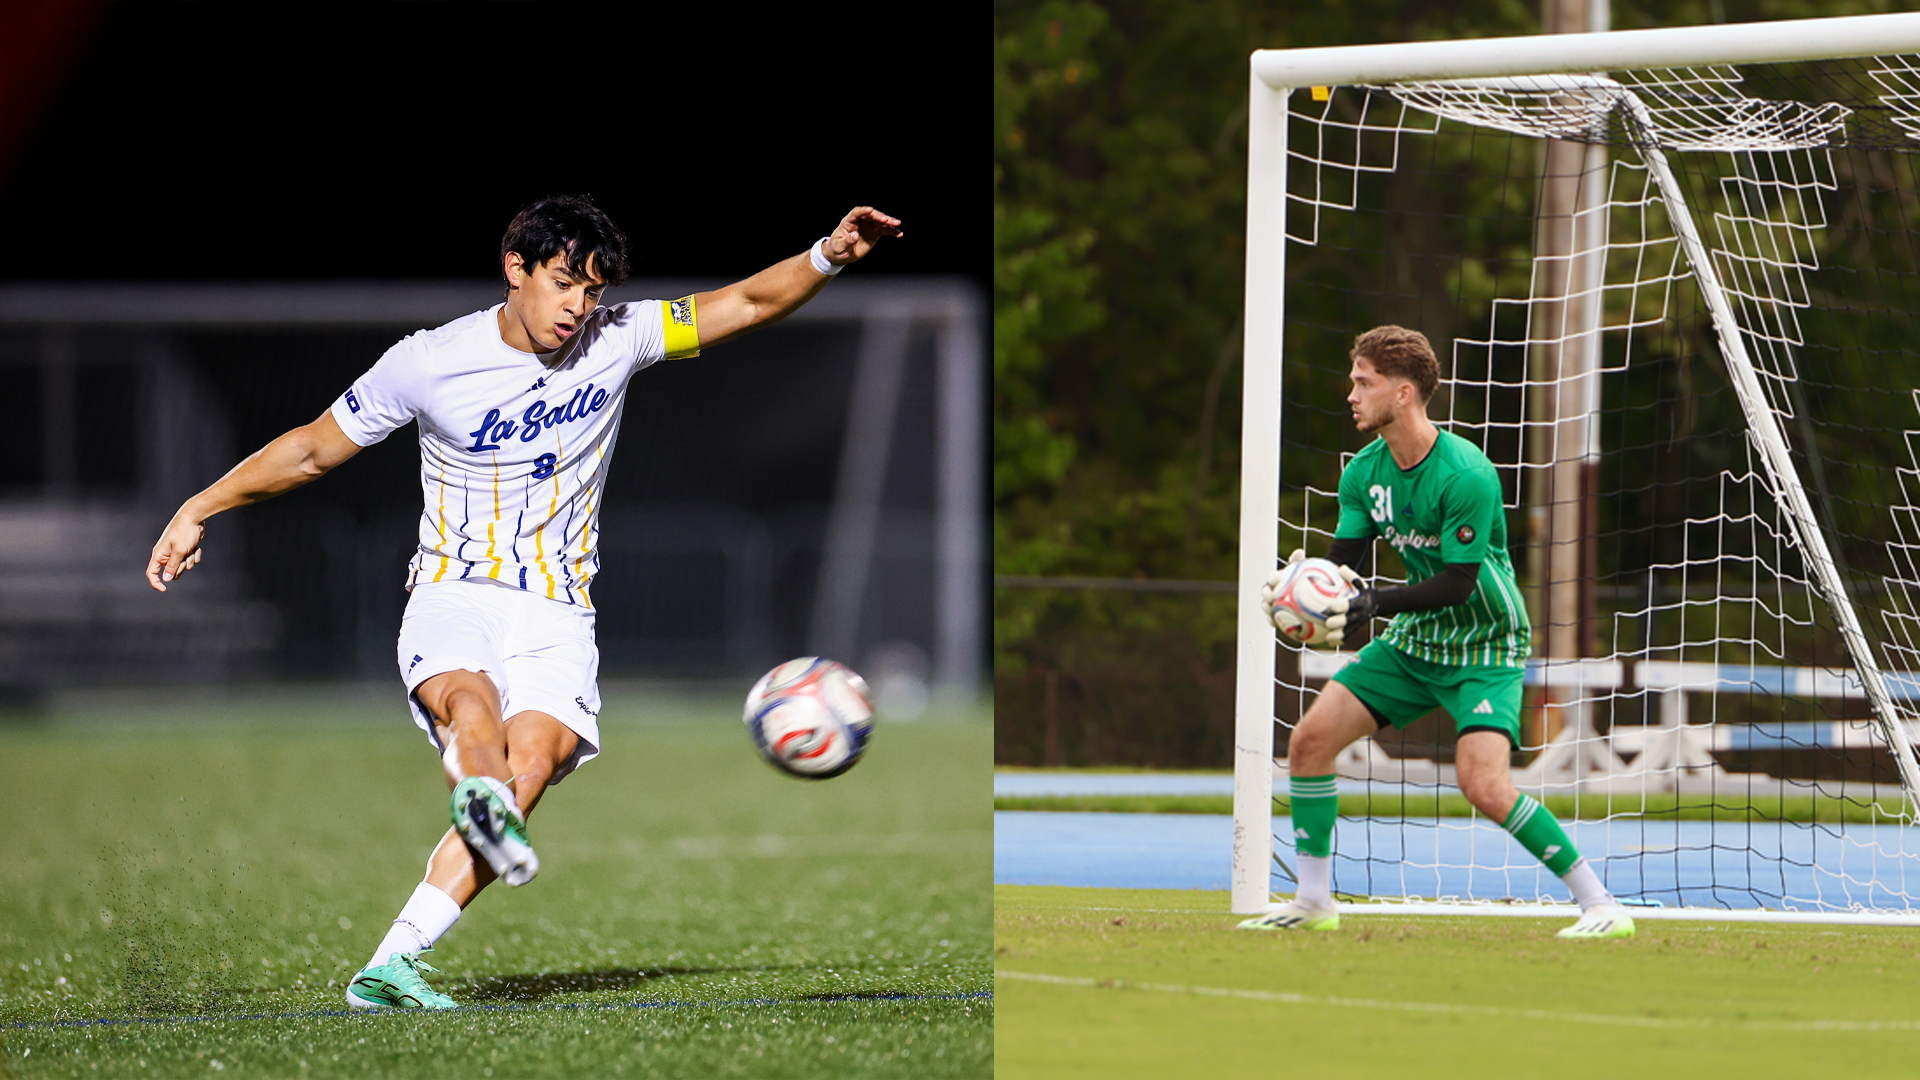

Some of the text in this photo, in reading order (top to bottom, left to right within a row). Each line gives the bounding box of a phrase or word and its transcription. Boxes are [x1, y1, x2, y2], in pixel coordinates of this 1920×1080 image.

[344, 383, 361, 414] 10
[465, 383, 610, 452] La Salle
[531, 452, 557, 479] 8
[1369, 484, 1394, 523] 31
[1385, 526, 1441, 553] Explore
